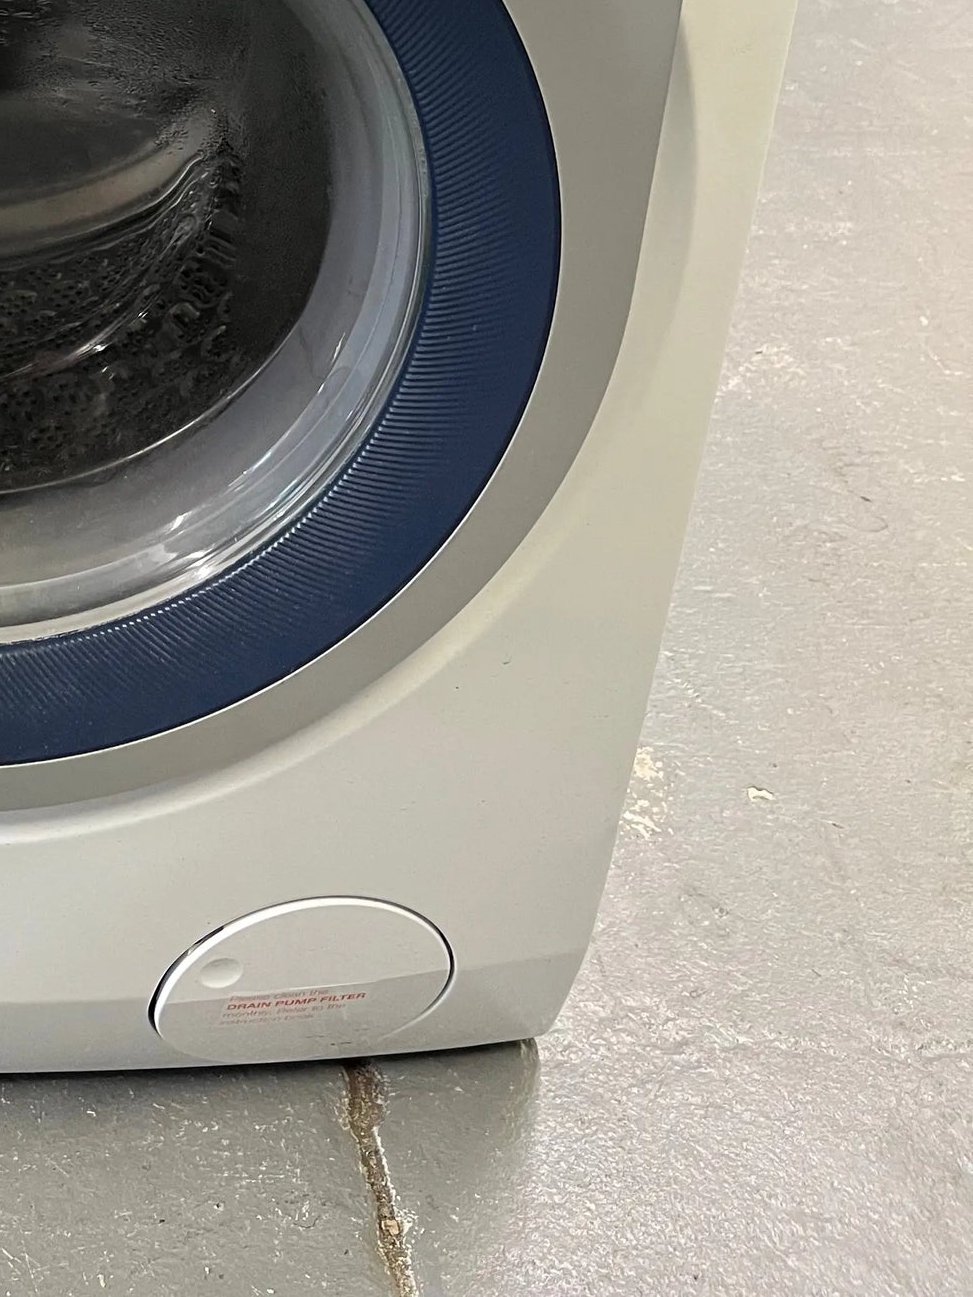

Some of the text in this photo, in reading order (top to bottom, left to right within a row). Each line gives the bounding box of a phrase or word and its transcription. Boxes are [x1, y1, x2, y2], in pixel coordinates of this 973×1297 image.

[227, 992, 366, 1011] DRAIN PUMP FILTER
